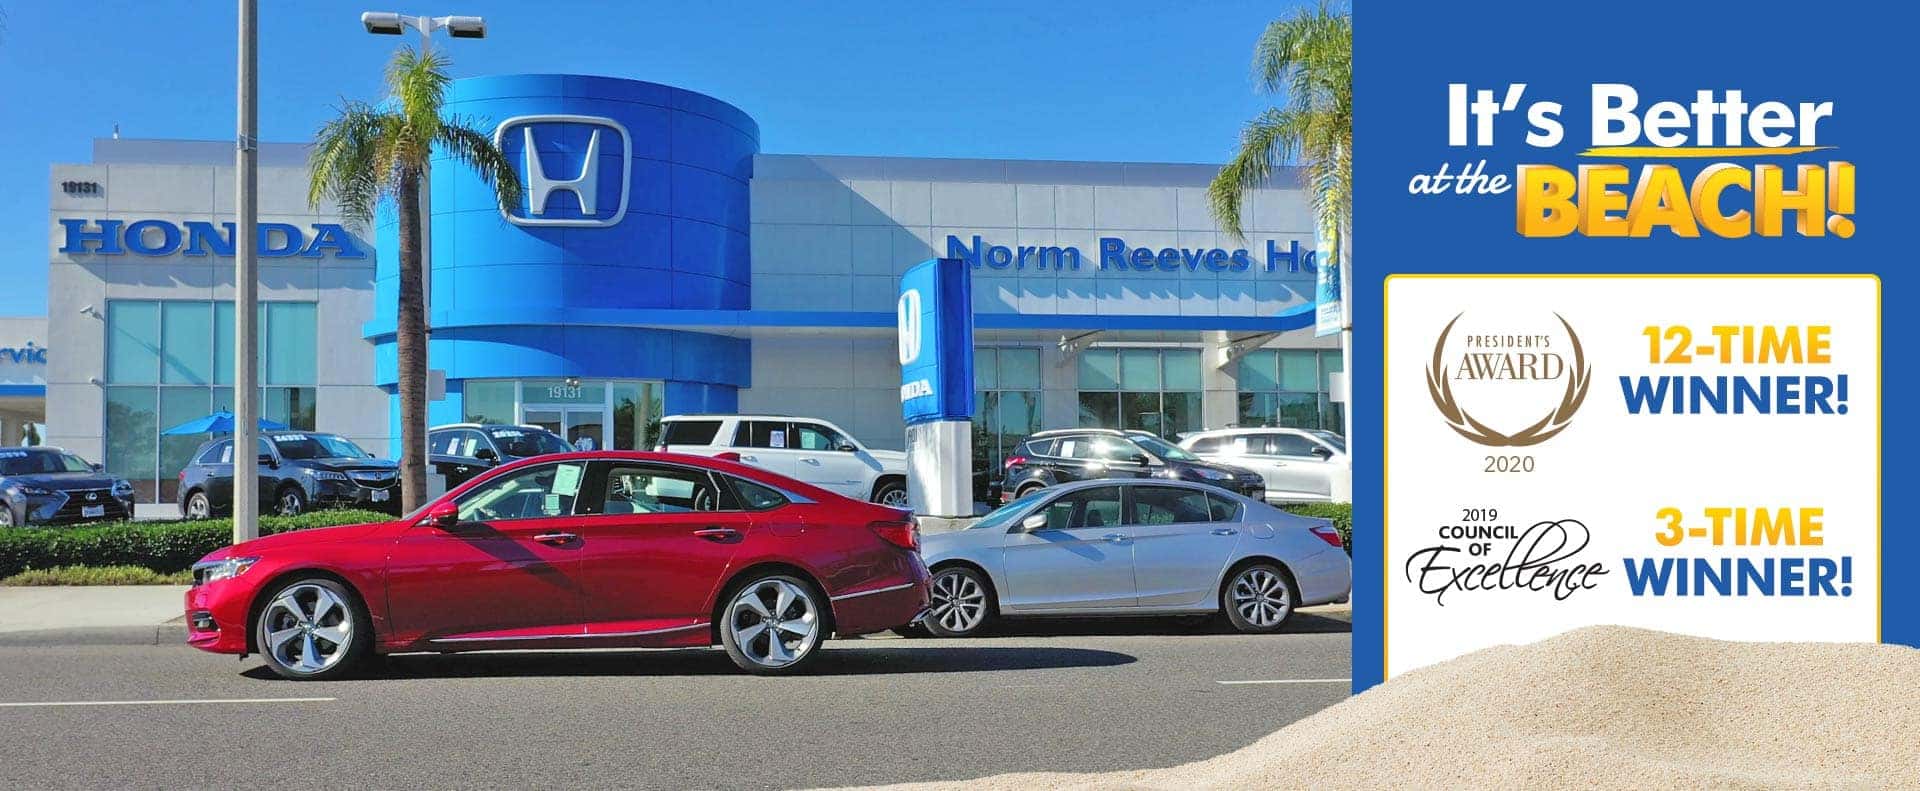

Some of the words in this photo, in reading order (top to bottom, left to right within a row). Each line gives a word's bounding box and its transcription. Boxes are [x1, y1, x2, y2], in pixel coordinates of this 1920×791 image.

[61, 181, 98, 194] 19131
[58, 217, 367, 259] HONDA
[946, 234, 1081, 271] Norm
[1099, 237, 1251, 272] Reeves
[547, 386, 581, 398] 19131
